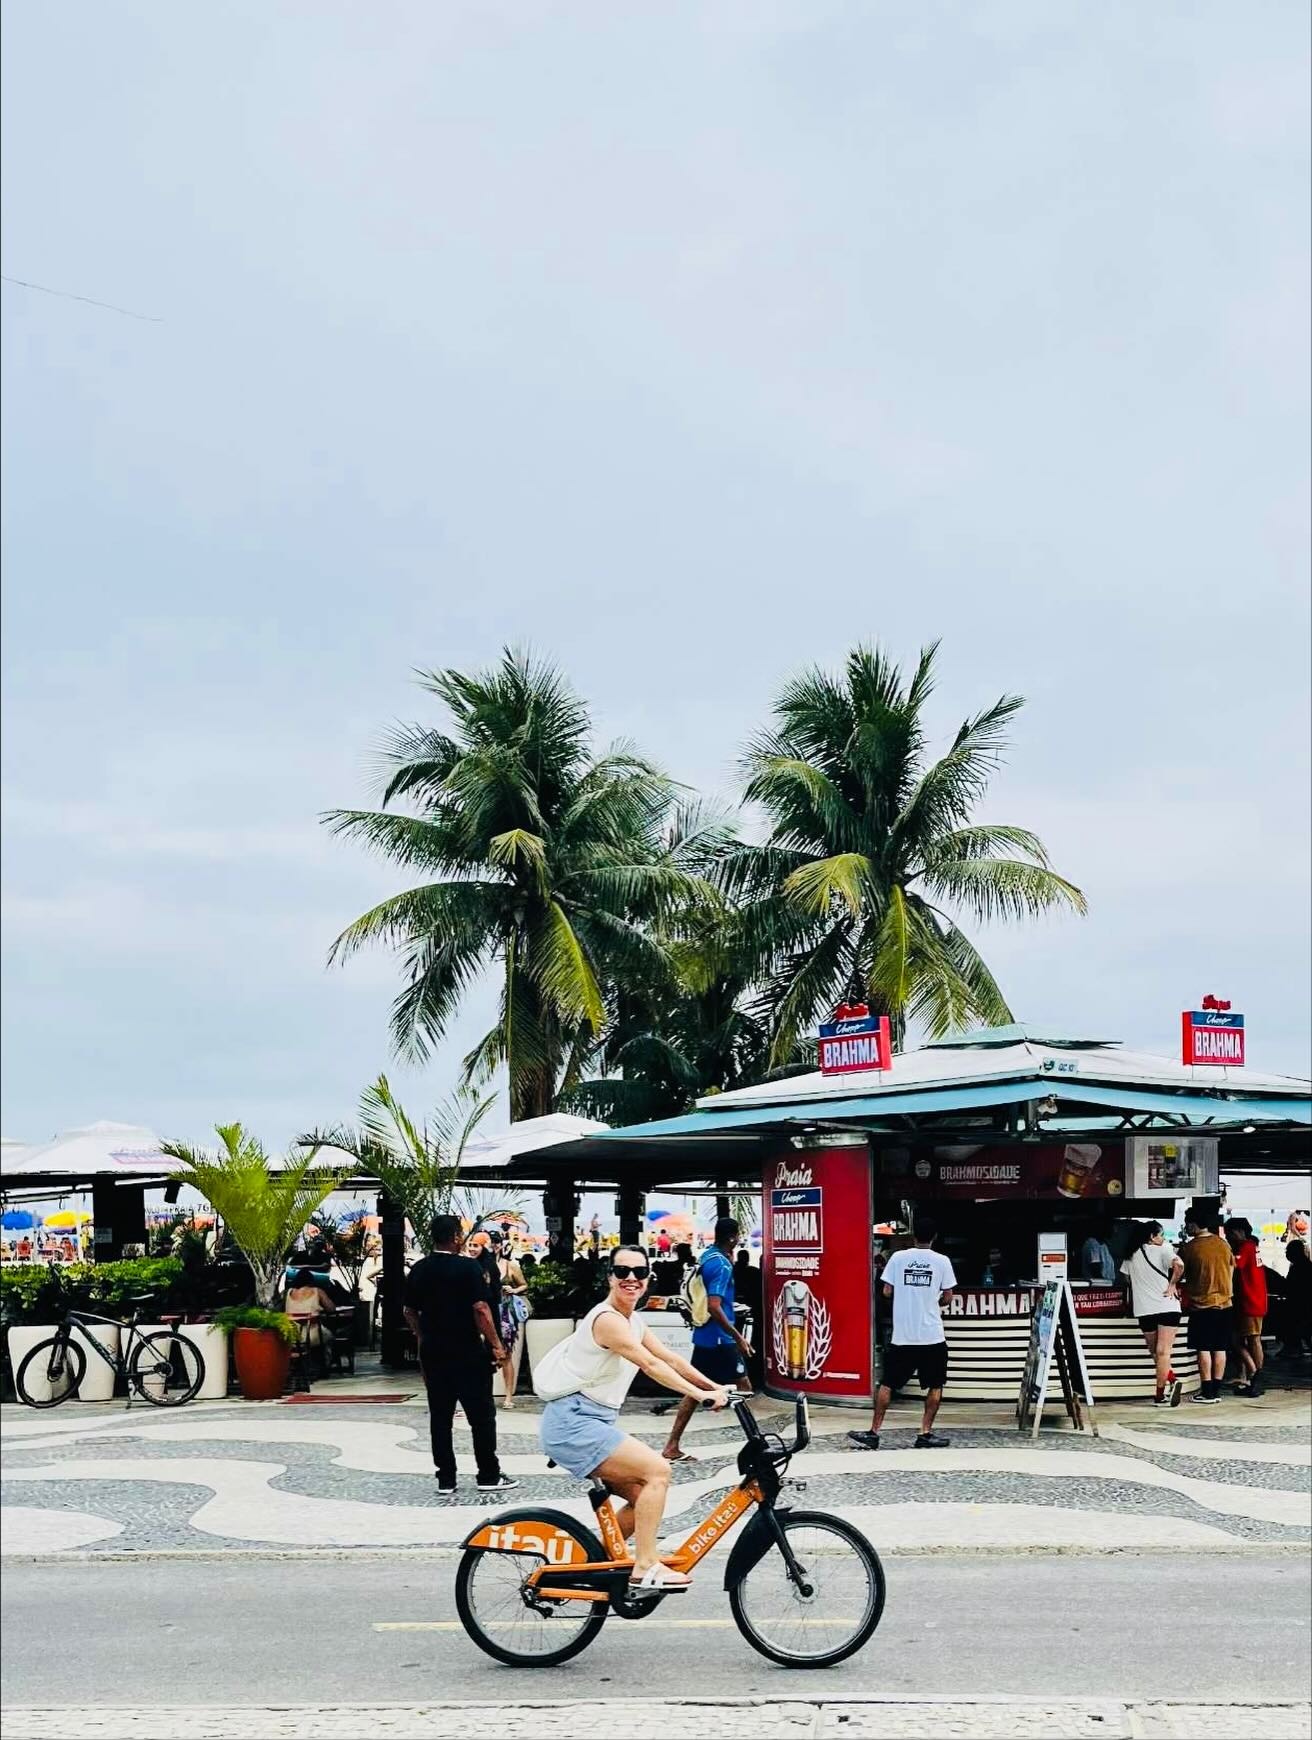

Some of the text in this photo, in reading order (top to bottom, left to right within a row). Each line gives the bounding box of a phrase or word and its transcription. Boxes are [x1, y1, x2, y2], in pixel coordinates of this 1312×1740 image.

[823, 1037, 879, 1068] BRAHMA
[1194, 1030, 1242, 1058] BRAHMA
[775, 1161, 812, 1188] Praia
[773, 1211, 818, 1241] BRAHMA
[688, 1526, 718, 1554] bike
